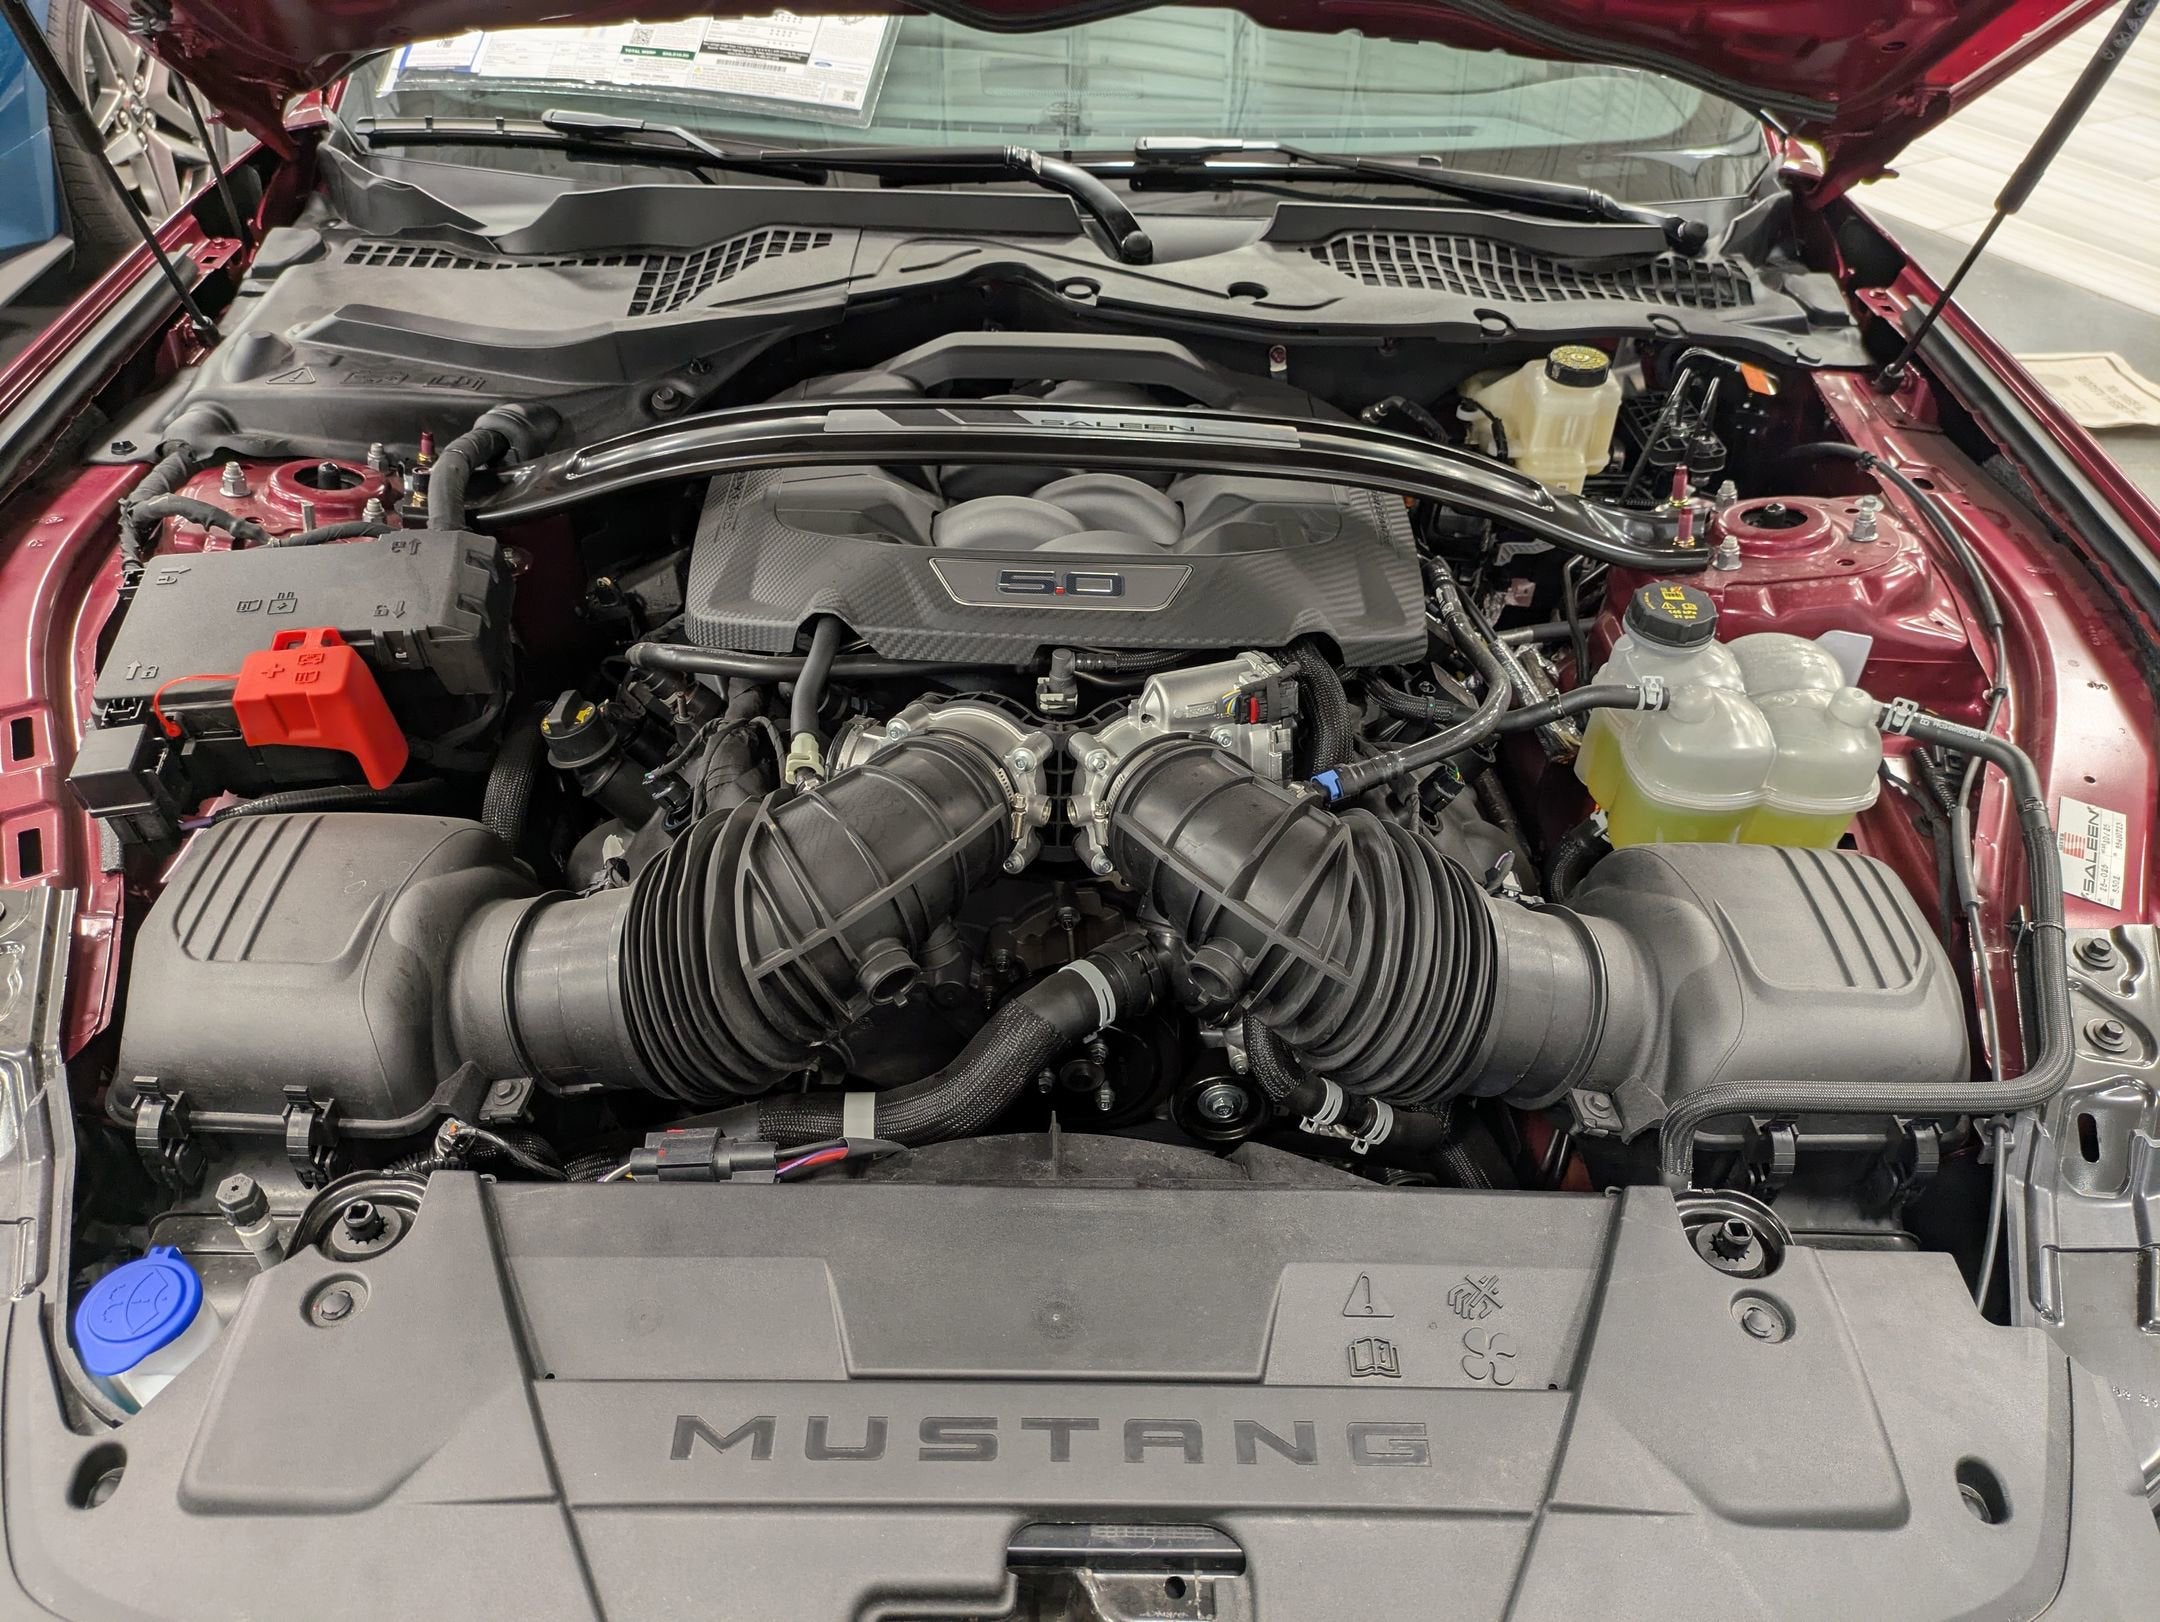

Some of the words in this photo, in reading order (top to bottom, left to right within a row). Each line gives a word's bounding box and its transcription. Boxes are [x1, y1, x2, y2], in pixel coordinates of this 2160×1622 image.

[1041, 419, 1195, 432] SALEEN
[998, 569, 1124, 598] 5.0
[2083, 808, 2100, 895] SALEEN
[669, 1415, 1433, 1468] MUSTANG
